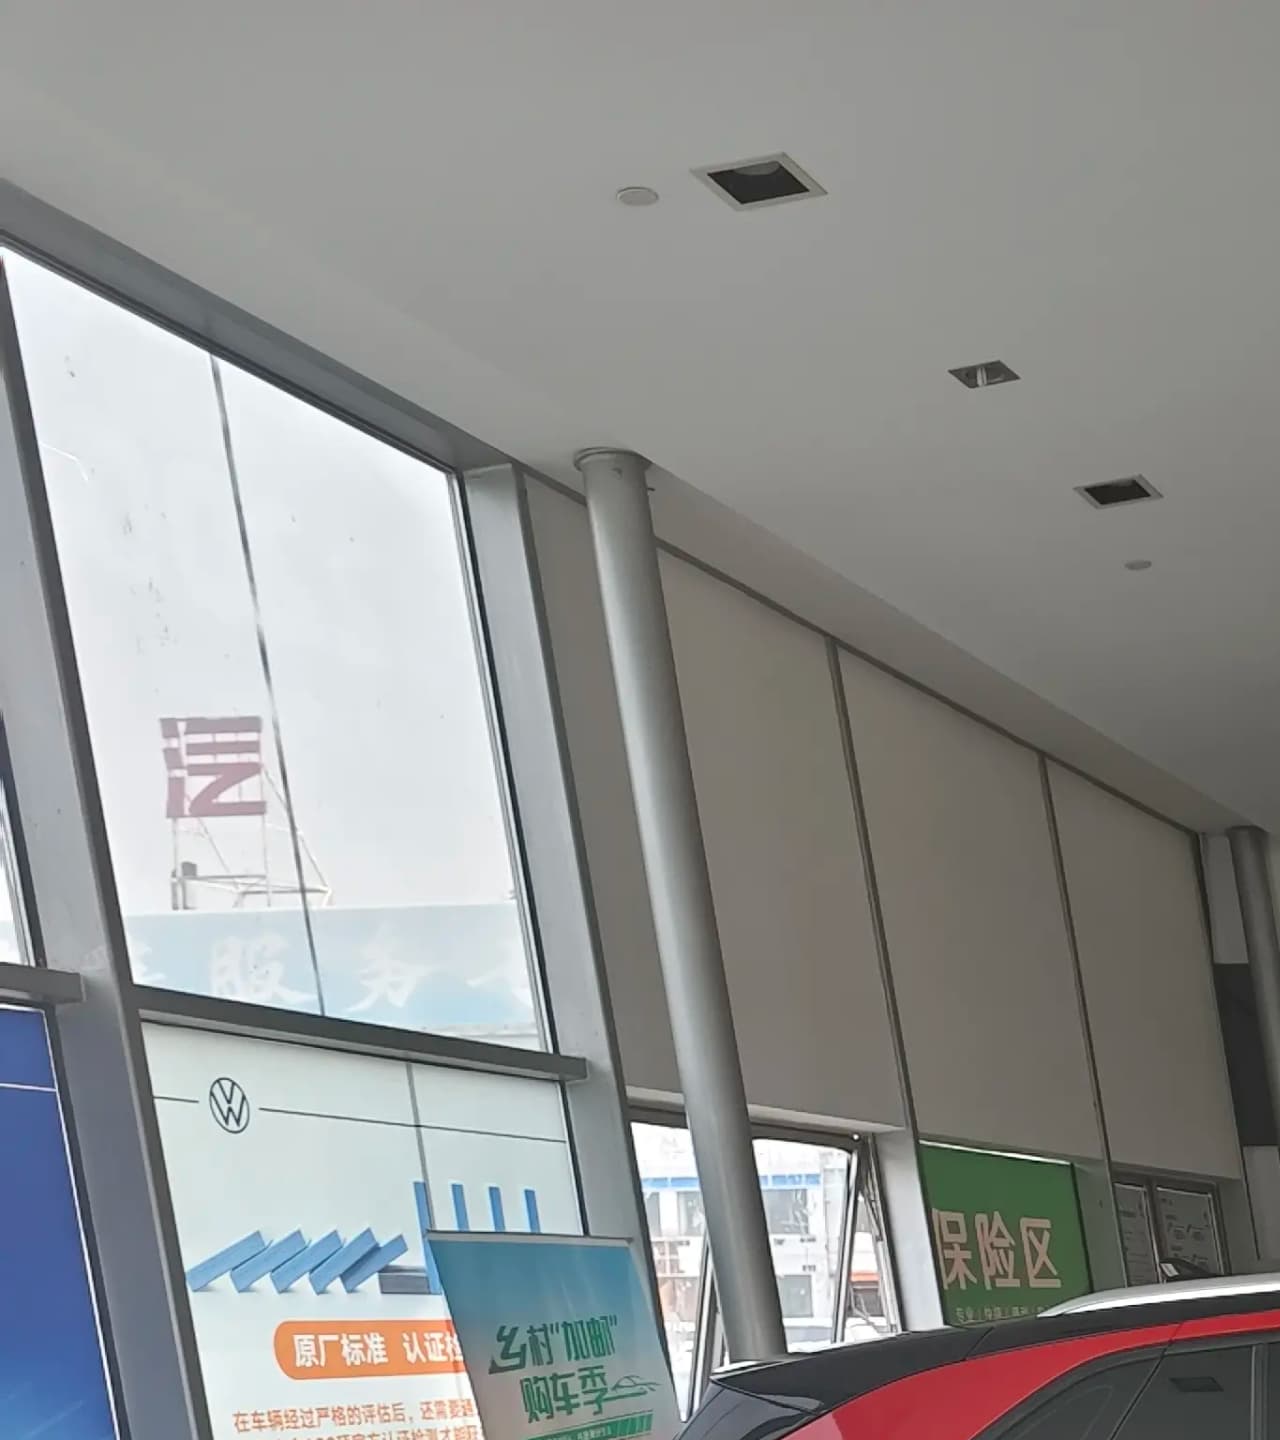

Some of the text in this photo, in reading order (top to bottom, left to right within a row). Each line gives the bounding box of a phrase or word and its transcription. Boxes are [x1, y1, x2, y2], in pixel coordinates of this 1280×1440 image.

[932, 1208, 1062, 1291] 保险区
[293, 1334, 388, 1368] 原厂标准
[520, 1365, 609, 1424] 购车季
